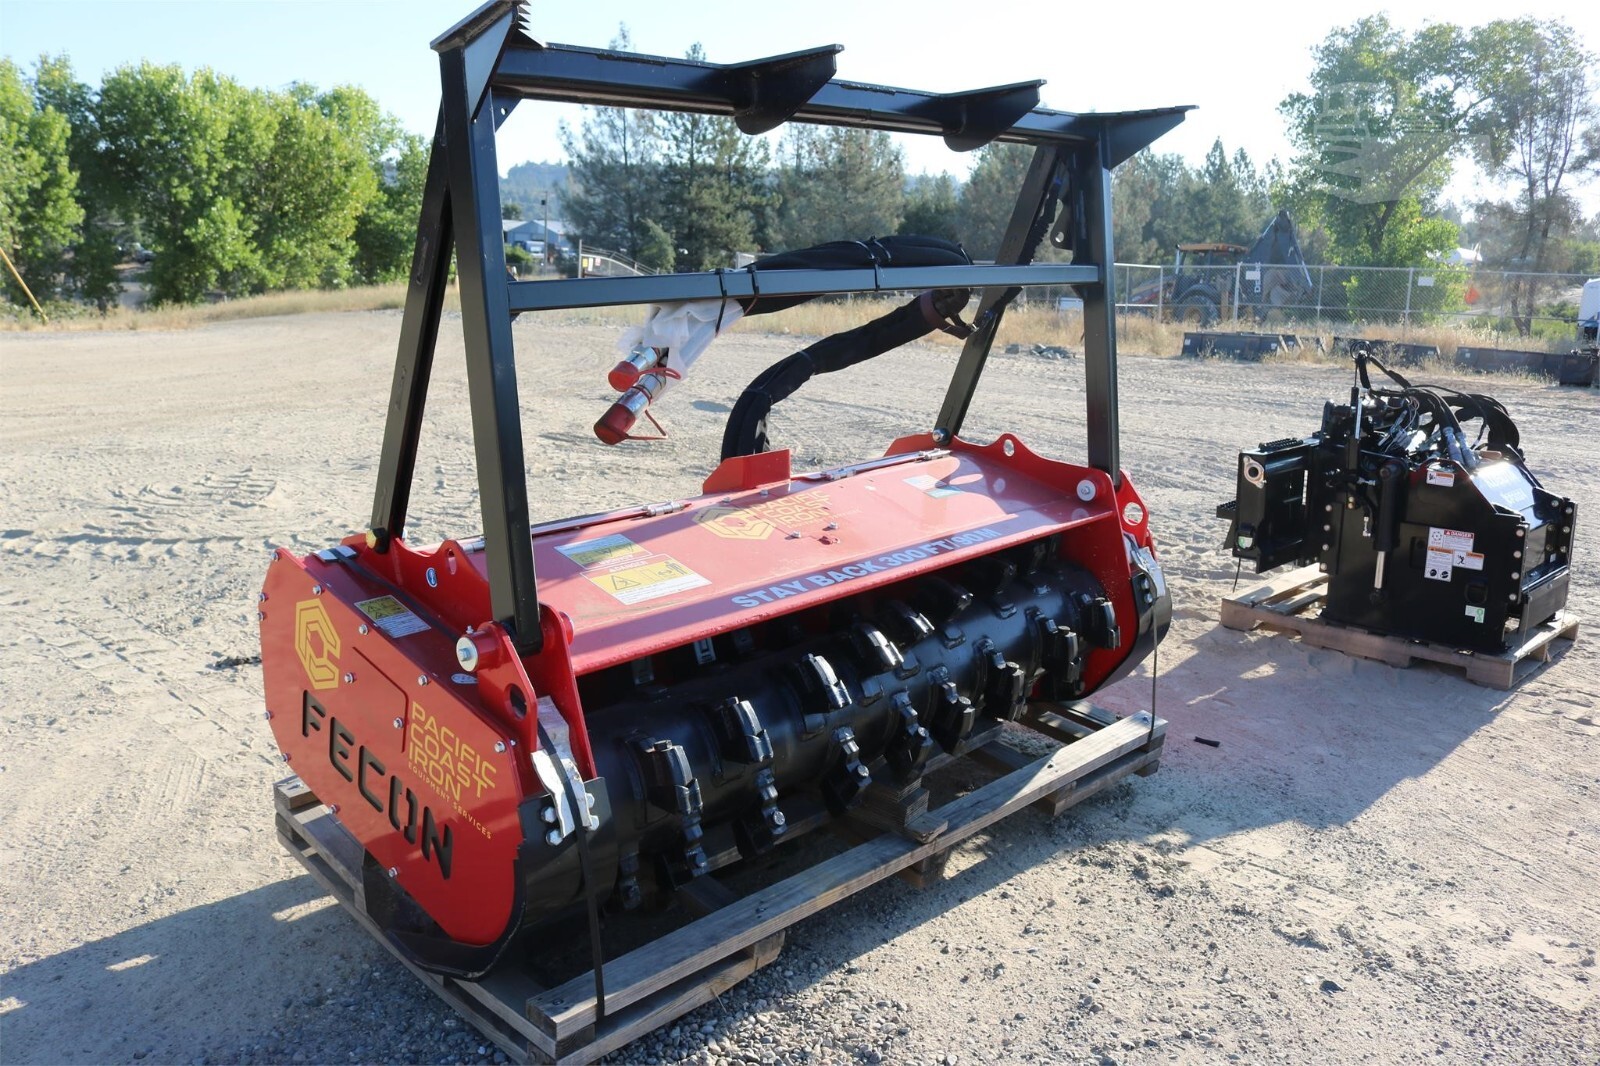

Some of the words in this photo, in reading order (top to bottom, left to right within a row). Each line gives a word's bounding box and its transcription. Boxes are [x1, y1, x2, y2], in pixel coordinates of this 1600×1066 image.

[754, 490, 830, 512] PACIFIC
[763, 499, 833, 519] COAST
[774, 509, 830, 526] IRON
[731, 580, 810, 608] STAY
[806, 561, 885, 588] BACK
[409, 741, 461, 802] IRON
[410, 722, 488, 799] COAST
[411, 700, 497, 789] PACIFIC
[302, 689, 453, 881] FECON
[408, 760, 451, 803] EQUIPMENT
[453, 801, 492, 840] SERVICES
